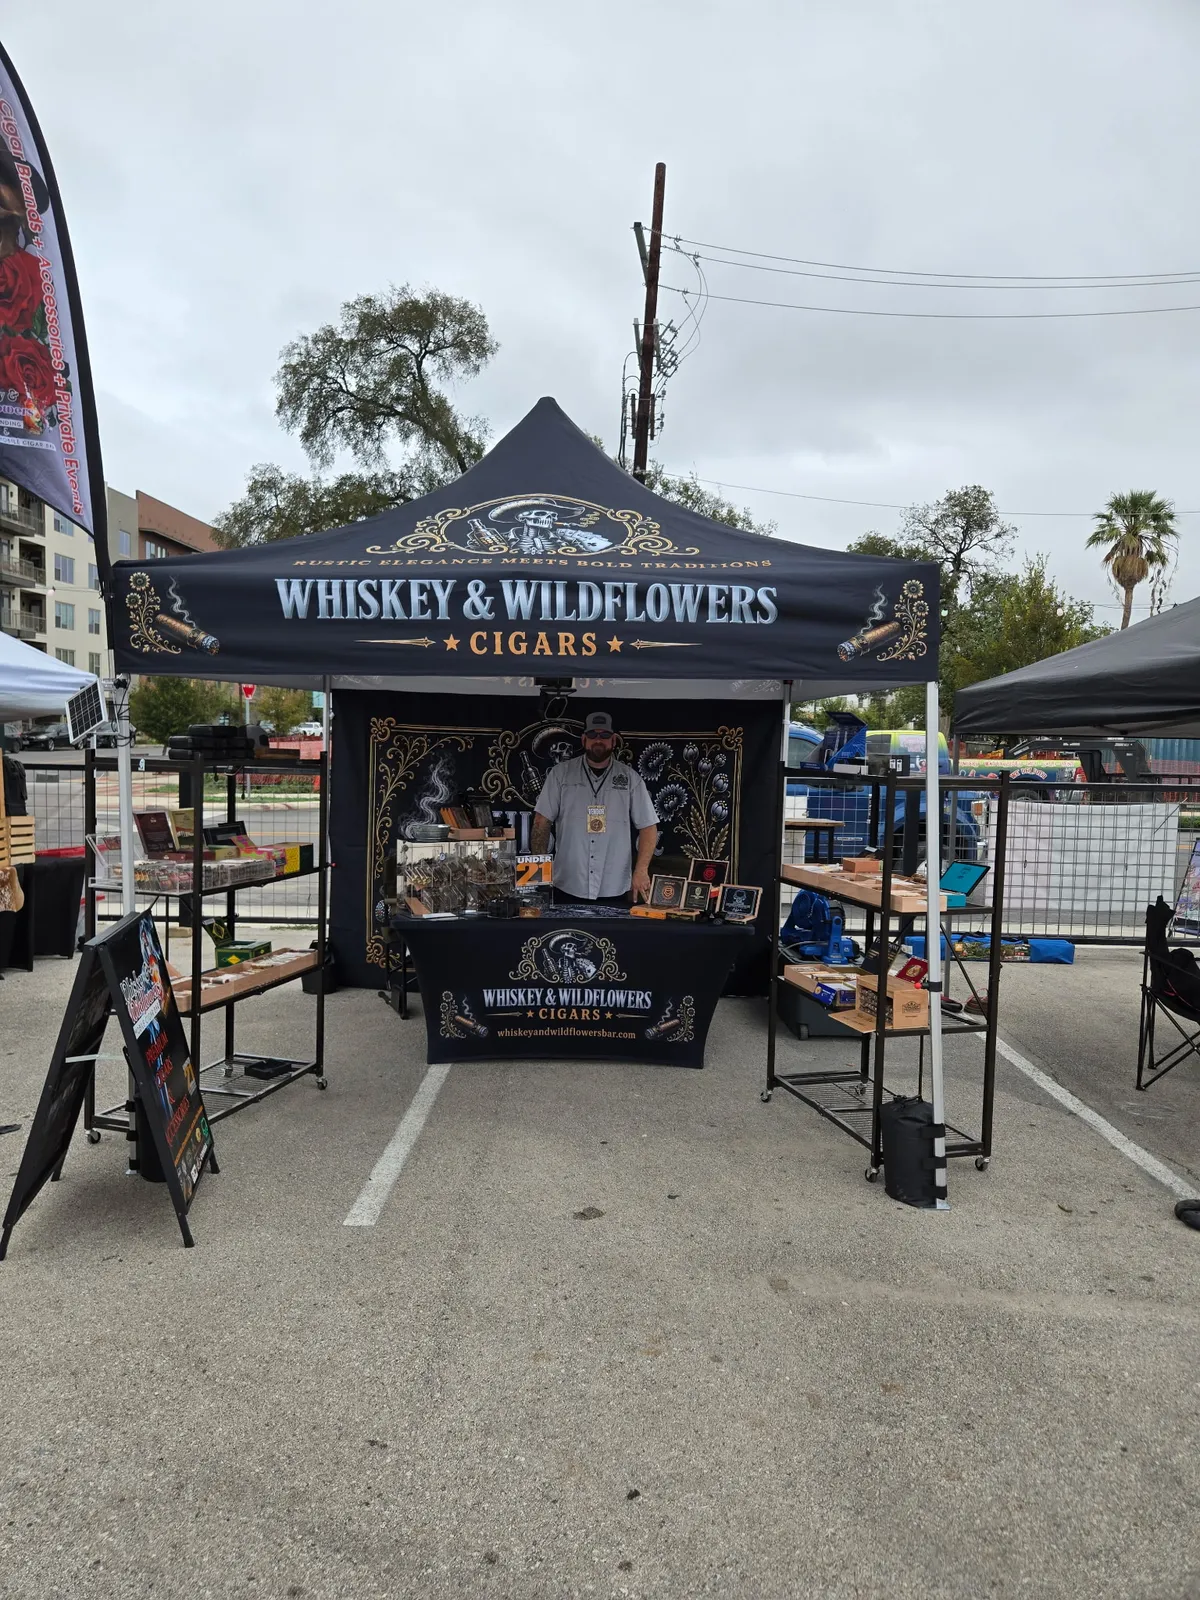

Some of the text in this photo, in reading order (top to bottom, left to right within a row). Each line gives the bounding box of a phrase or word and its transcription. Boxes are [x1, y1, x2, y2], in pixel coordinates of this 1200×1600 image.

[0, 99, 26, 161] Cigar
[14, 162, 43, 233] Brands
[37, 252, 65, 371] Accessories
[55, 390, 76, 454] Private
[64, 458, 84, 516] Events
[378, 558, 493, 566] ELEGANCE
[501, 557, 568, 566] MEETS
[576, 560, 633, 568] BOLD
[641, 559, 772, 569] TRADITIONS
[274, 578, 779, 625] WHISKEY & WILDFLOWERS
[470, 631, 597, 656] CIGARS
[517, 856, 552, 864] UNDER
[516, 861, 552, 887] 21
[482, 987, 652, 1010] WHISKEY & WILDFLOWERS
[538, 1008, 601, 1021] CIGARS
[497, 1026, 636, 1040] whiskeyandwildflowersbar.com
